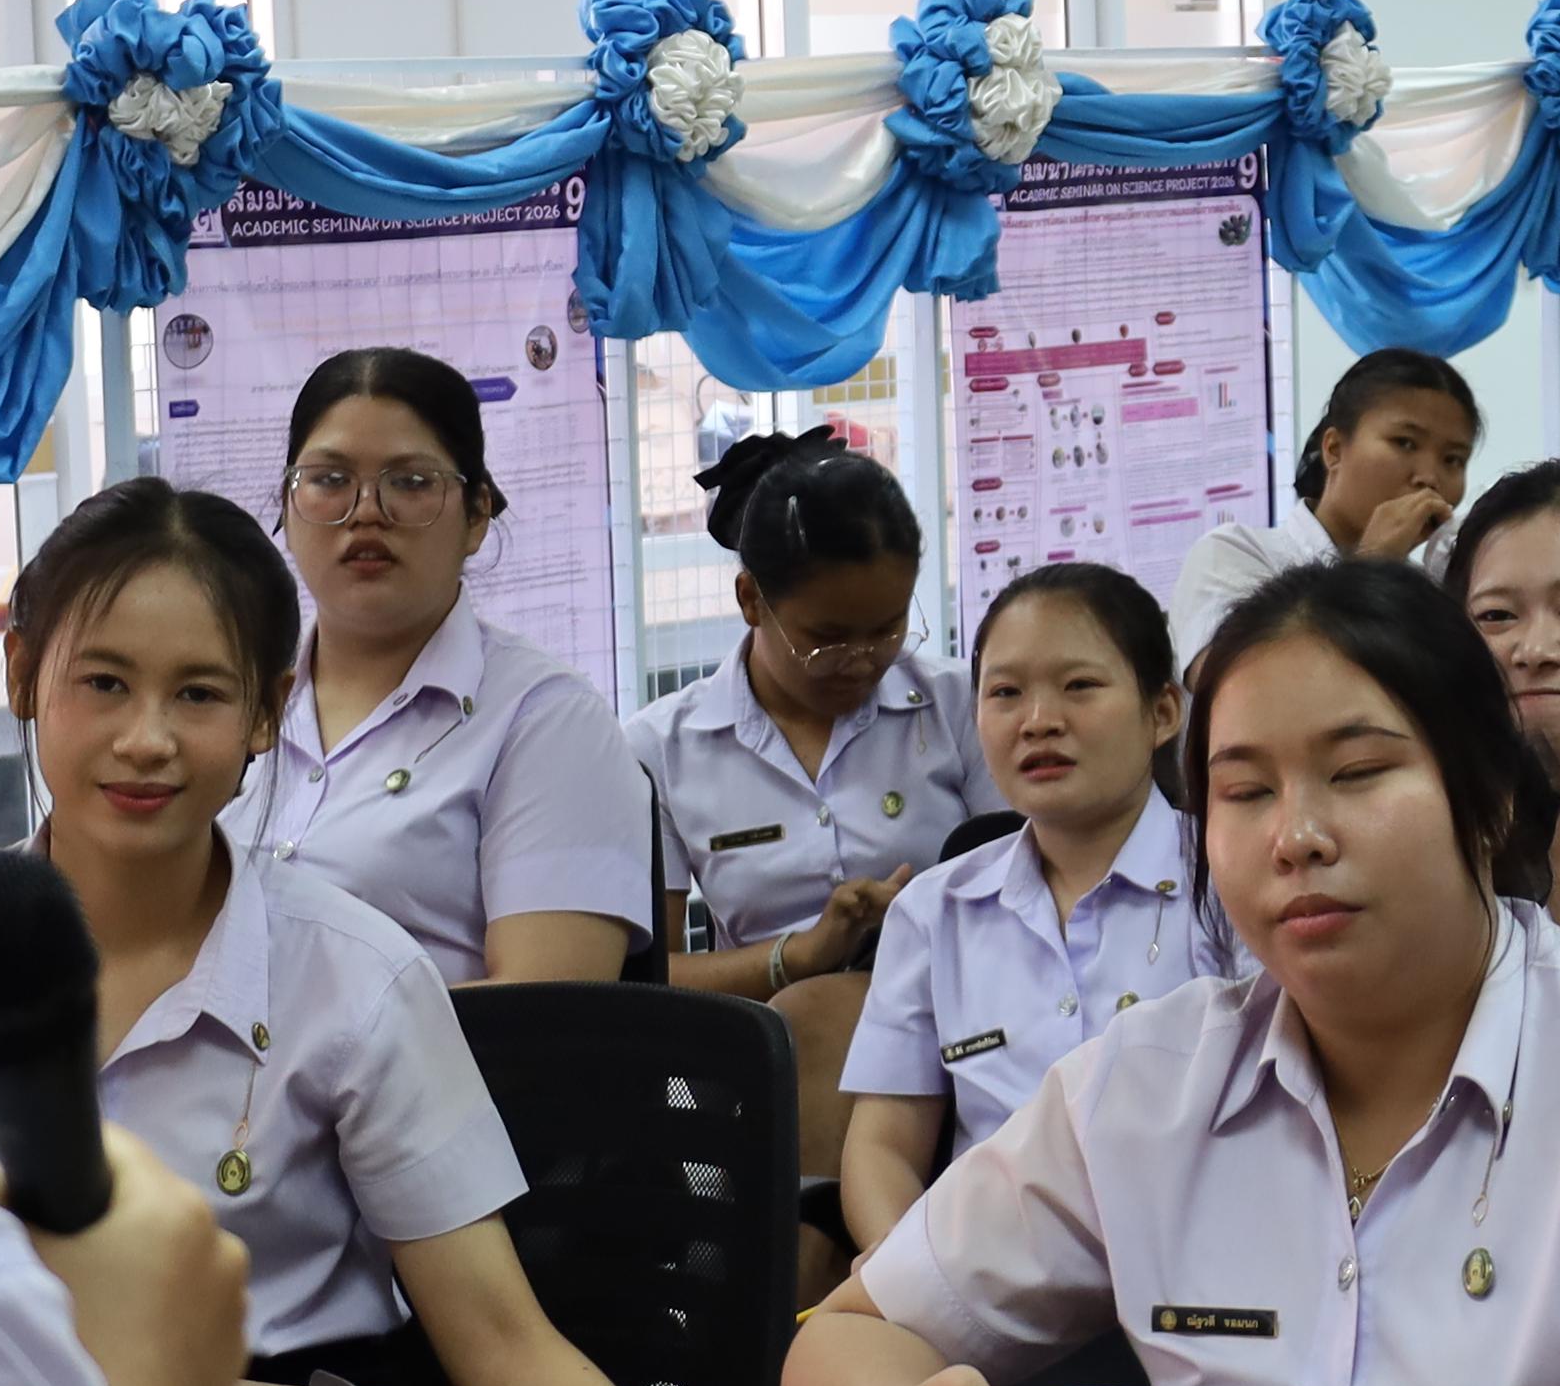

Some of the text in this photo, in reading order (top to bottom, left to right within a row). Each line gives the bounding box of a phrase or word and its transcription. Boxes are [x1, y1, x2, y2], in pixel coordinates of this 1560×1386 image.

[1060, 184, 1105, 199] SEMINAR
[1106, 183, 1121, 195] ON
[1122, 179, 1165, 195] SCIENCE
[1166, 177, 1210, 191] PROJECT
[1239, 153, 1258, 189] 9
[566, 176, 586, 221] 9
[232, 219, 310, 238] ACADEMIC
[311, 217, 380, 234] SEMINAR
[463, 207, 522, 225] PROJECT
[524, 204, 561, 221] 2026
